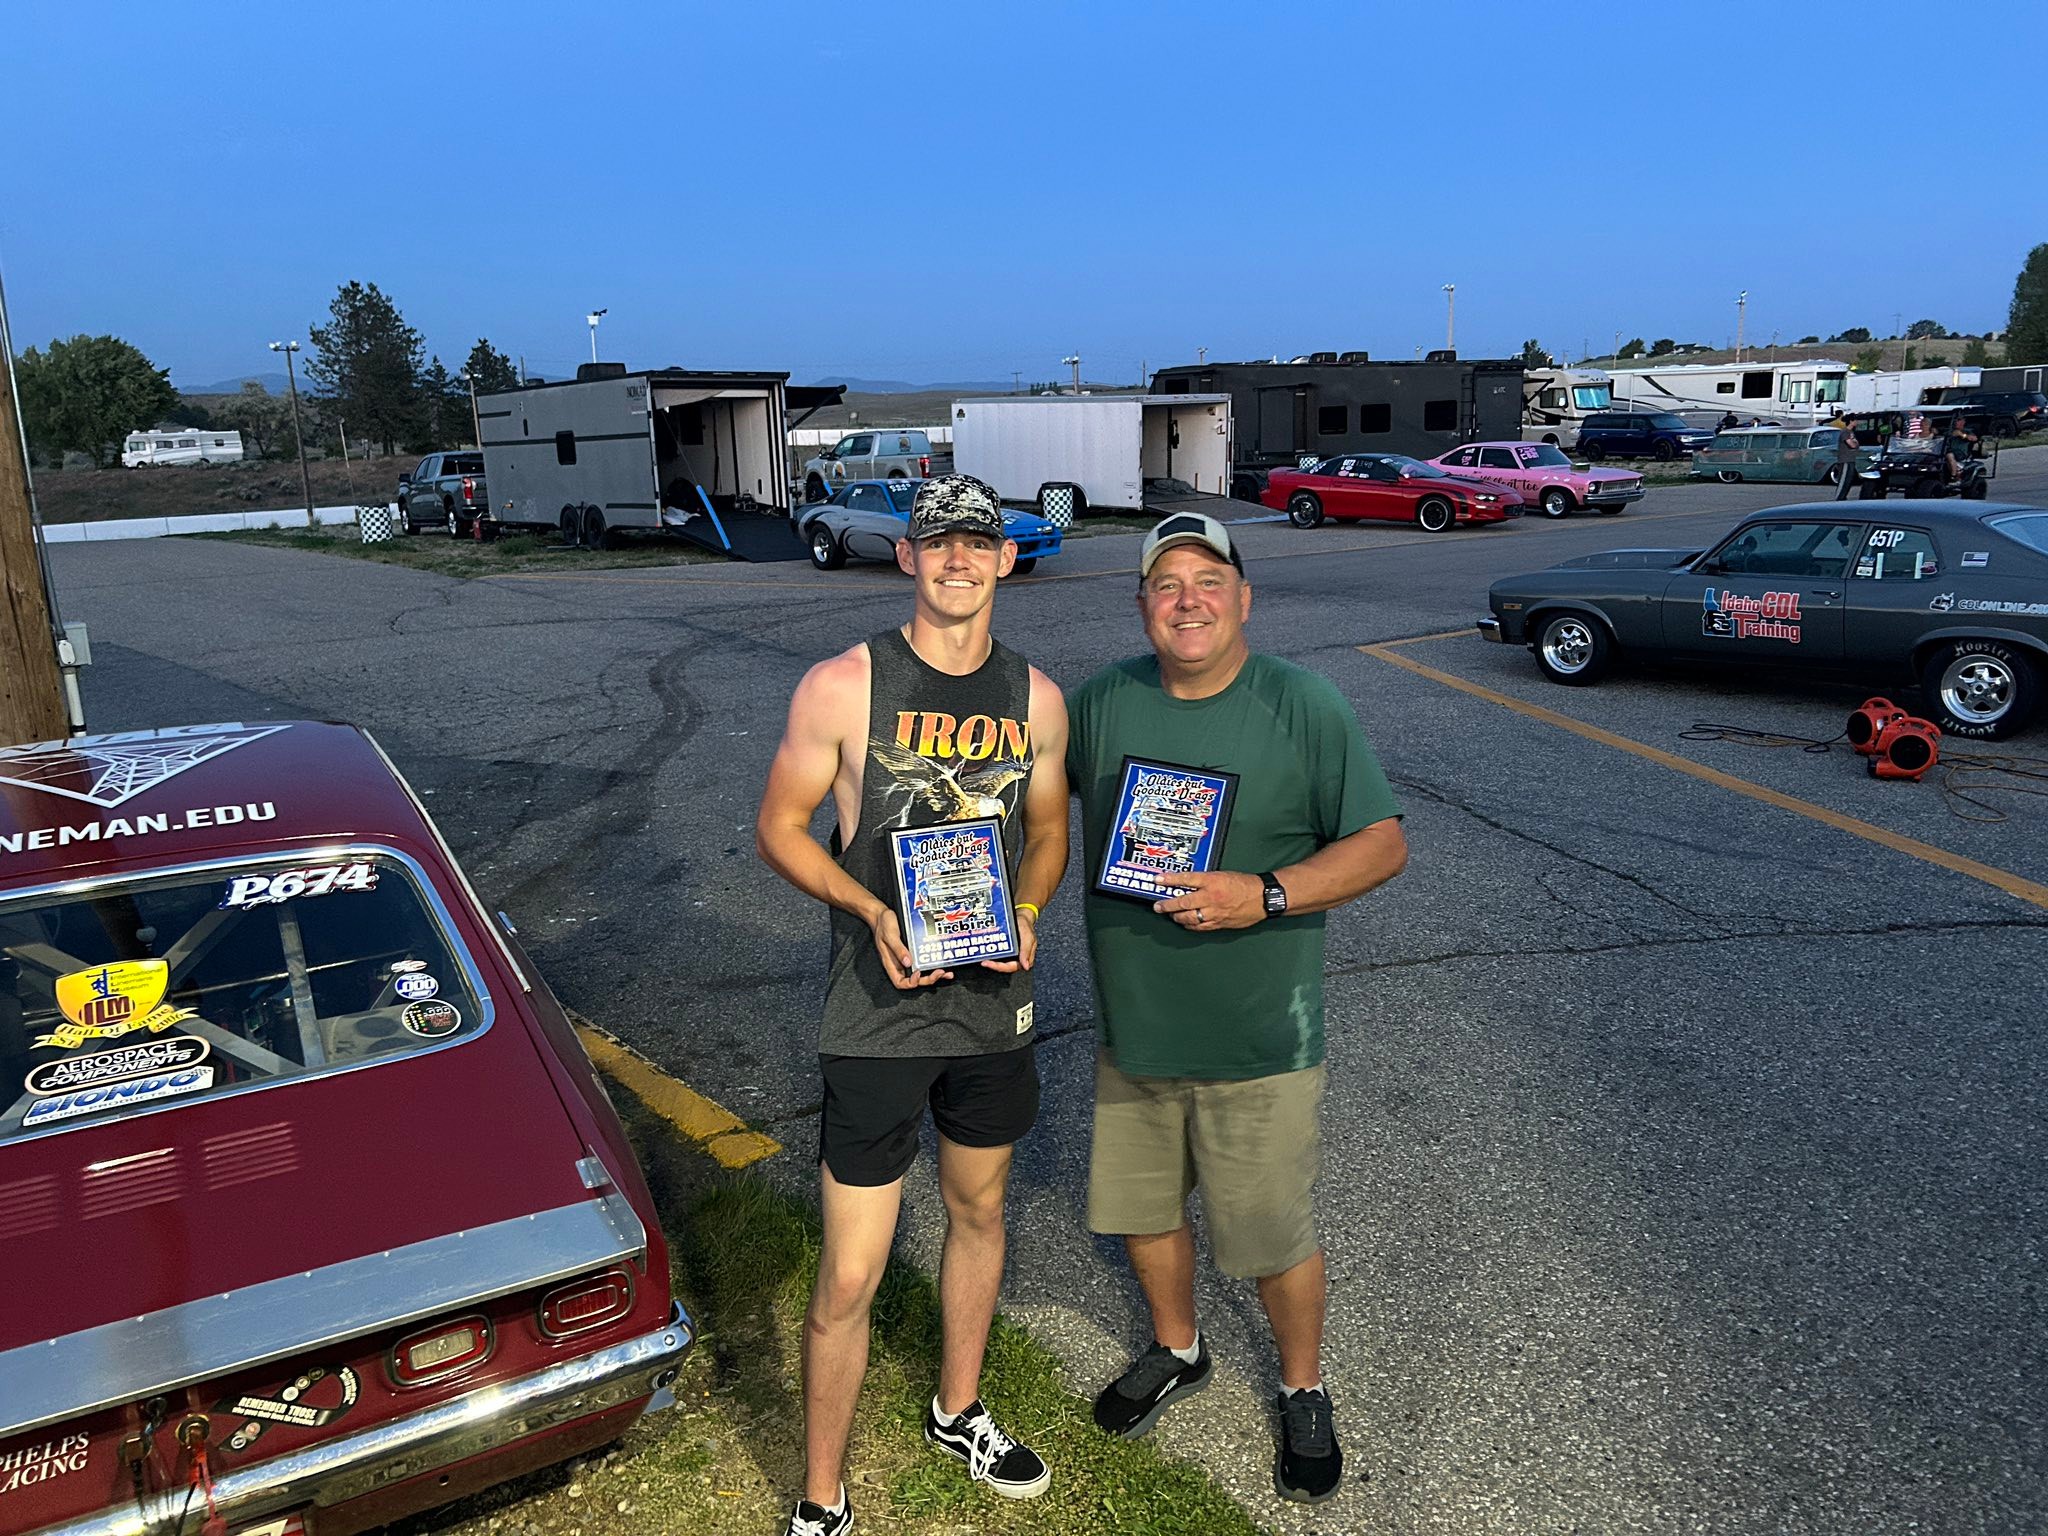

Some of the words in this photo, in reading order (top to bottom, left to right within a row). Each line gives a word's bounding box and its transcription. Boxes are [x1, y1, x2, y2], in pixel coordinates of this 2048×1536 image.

[1868, 529, 1905, 548] 651P
[1721, 590, 1761, 612] Idaho
[1761, 591, 1801, 620] CDL
[1731, 612, 1801, 643] Training
[895, 711, 1032, 764] IRON
[1132, 783, 1178, 798] Goodies
[1178, 787, 1216, 803] Drags
[1146, 774, 1182, 787] Oldies
[1184, 776, 1204, 789] but
[910, 848, 954, 869] Goodies
[955, 841, 990, 858] Drags
[920, 836, 955, 855] Oldies
[956, 831, 975, 844] but
[1122, 836, 1193, 873] Firebird
[224, 861, 379, 908] P674
[1105, 875, 1193, 897] CHAMPIO
[1133, 870, 1155, 882] DRA
[919, 909, 996, 936] Firebird
[919, 941, 1009, 963] CHAMPION
[943, 937, 970, 949] DRAG
[970, 933, 1007, 946] RACING
[58, 1025, 95, 1036] Hall
[99, 1025, 122, 1036] Of
[127, 1007, 170, 1030] Fame
[83, 995, 132, 1026] ILM
[40, 1050, 194, 1089] COMPONENTS
[53, 1041, 178, 1077] AEROSPACE
[27, 1070, 202, 1119] BIONDO
[28, 1107, 85, 1124] RACING
[238, 1396, 288, 1415] REMEMBER
[288, 1405, 318, 1420] THOSE
